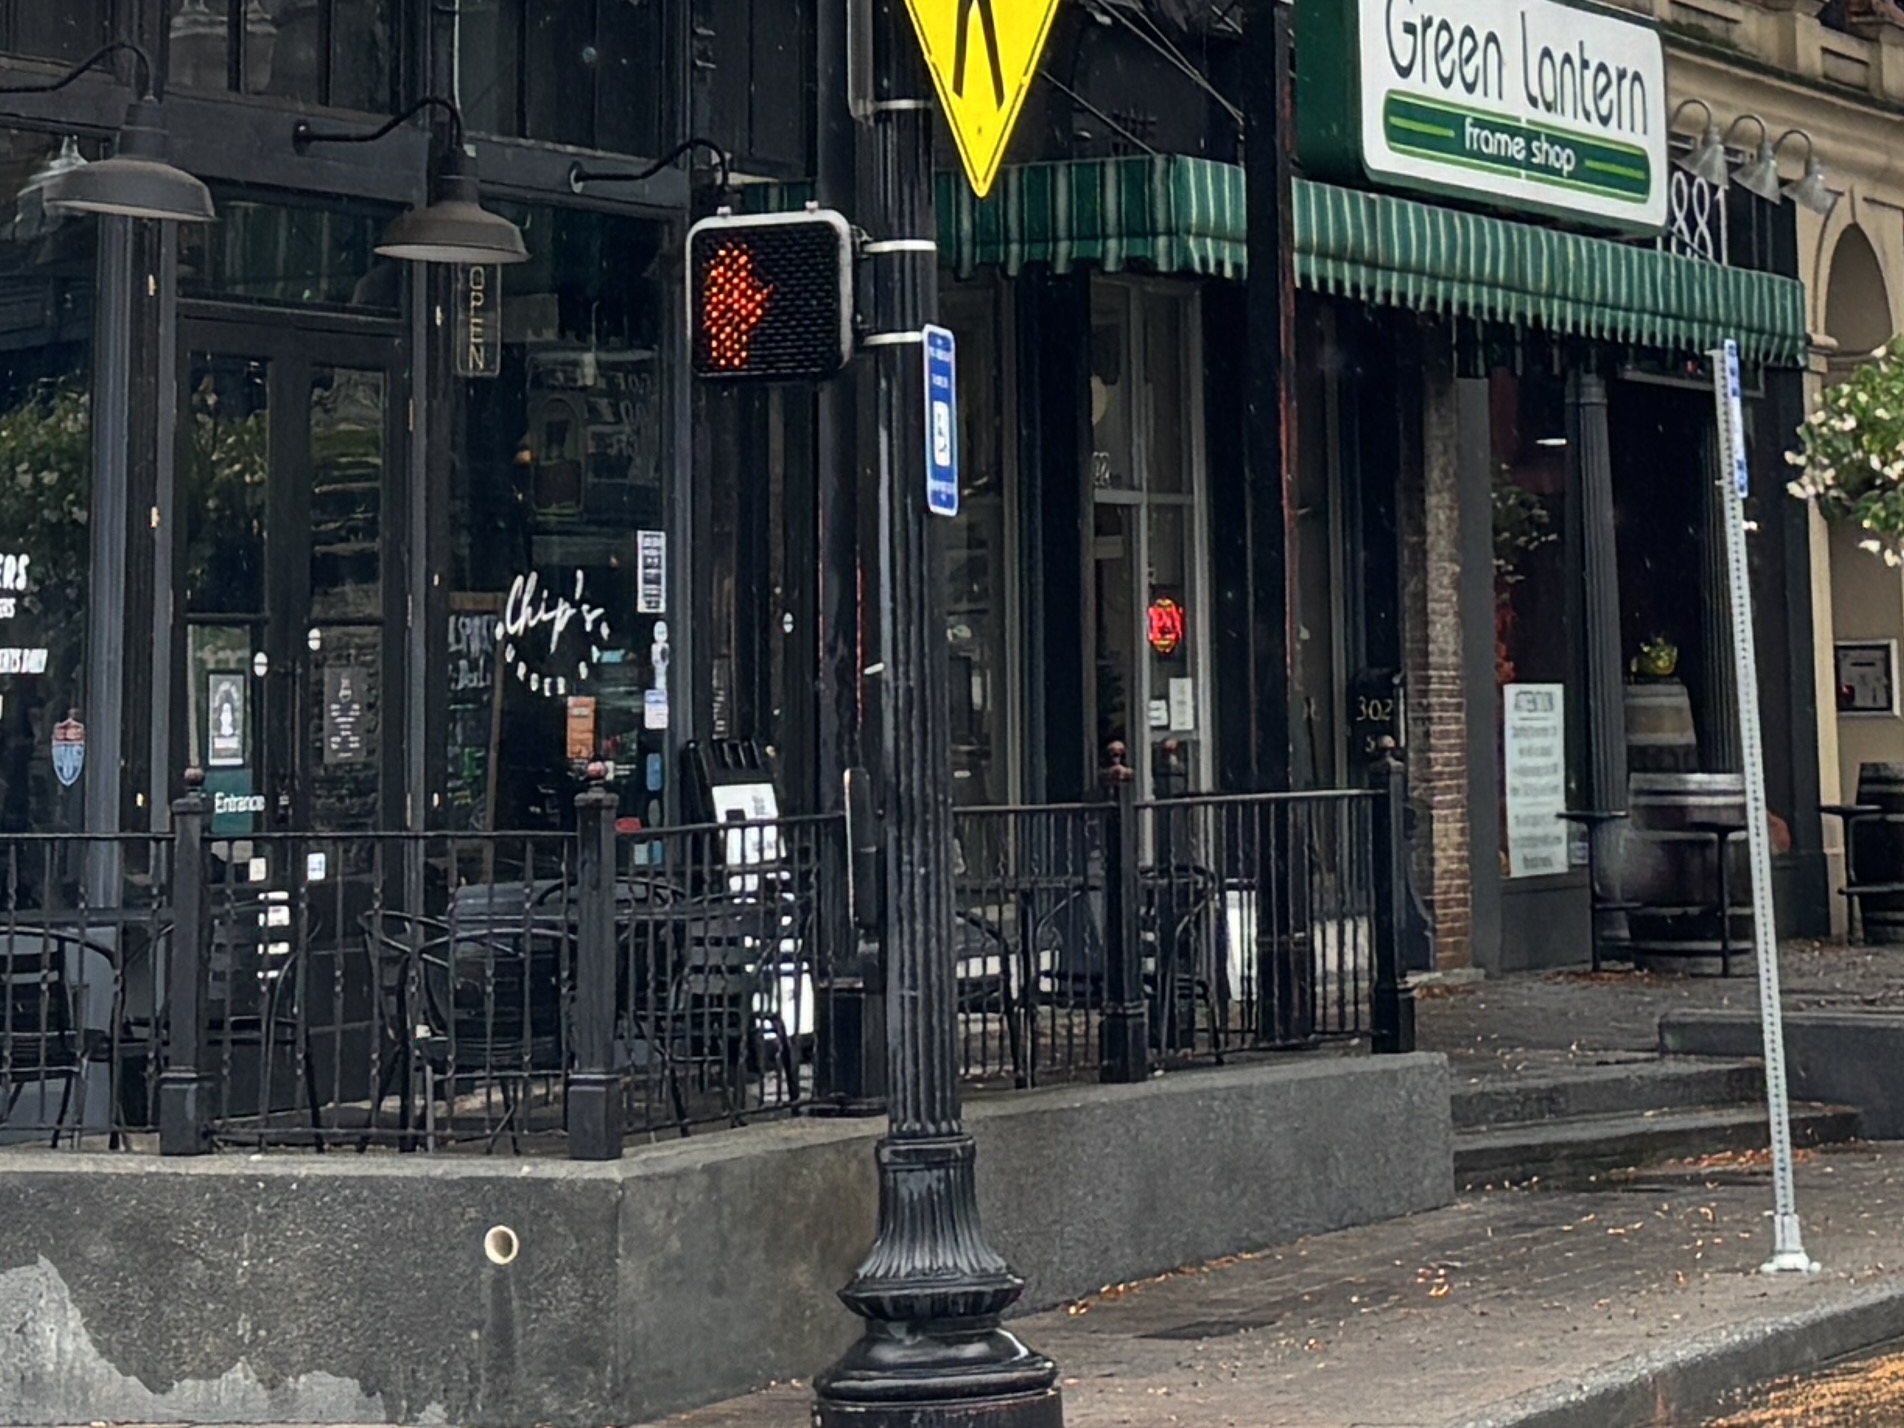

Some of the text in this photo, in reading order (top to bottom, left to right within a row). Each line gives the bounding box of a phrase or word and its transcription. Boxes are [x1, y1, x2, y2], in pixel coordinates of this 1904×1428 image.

[1520, 10, 1648, 135] Lantern
[1464, 117, 1575, 177] frame shop
[1655, 170, 1728, 267] 881
[469, 265, 485, 371] OPEN
[505, 569, 605, 654] Chip's
[1356, 695, 1393, 721] 302
[215, 791, 266, 814] Entrance
